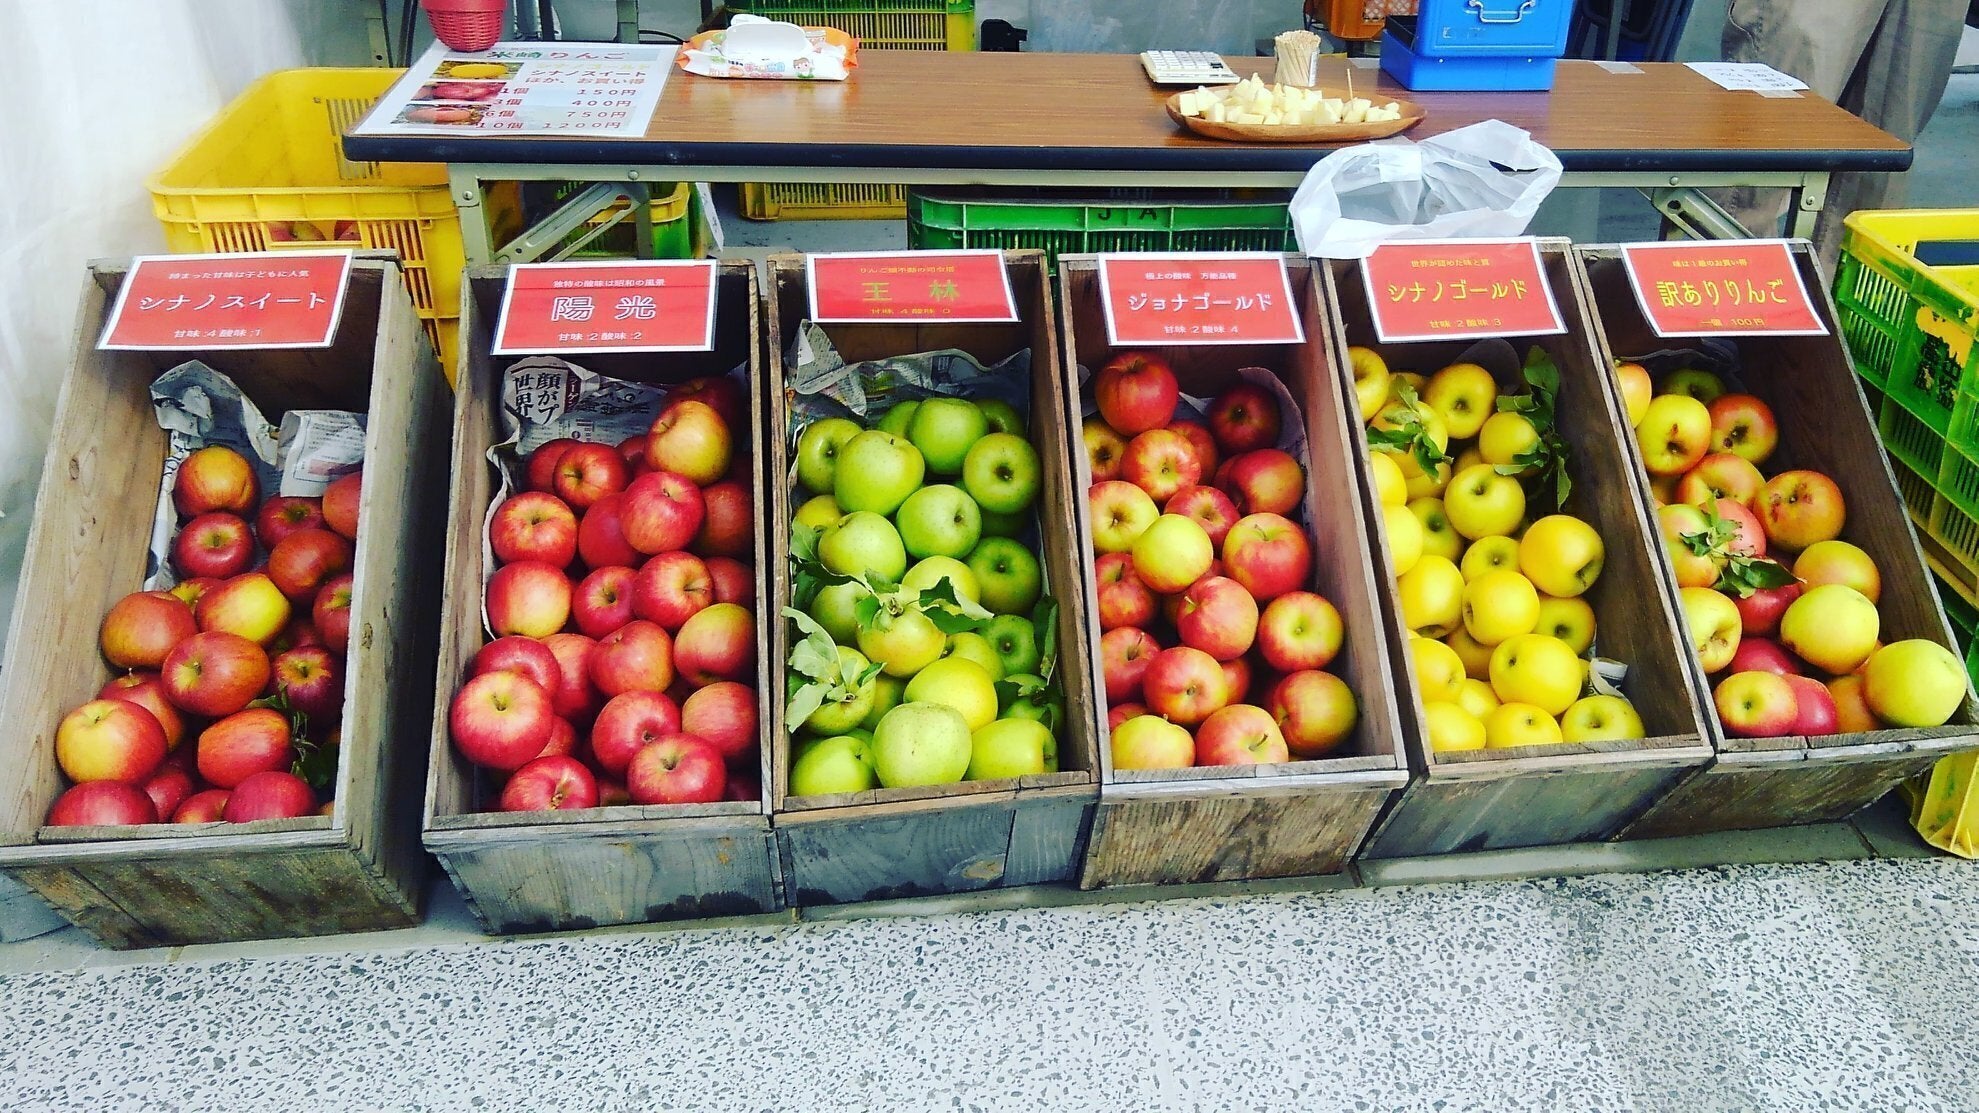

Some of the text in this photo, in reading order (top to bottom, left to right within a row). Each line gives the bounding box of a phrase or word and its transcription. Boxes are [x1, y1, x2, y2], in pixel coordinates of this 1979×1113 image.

[531, 69, 647, 77] シナノスイート
[1387, 278, 1529, 303] シナノゴールド
[1655, 277, 1789, 308] 訳ありりんご
[138, 292, 327, 312] シナノスイート
[1127, 292, 1273, 312] ジョナゴールド
